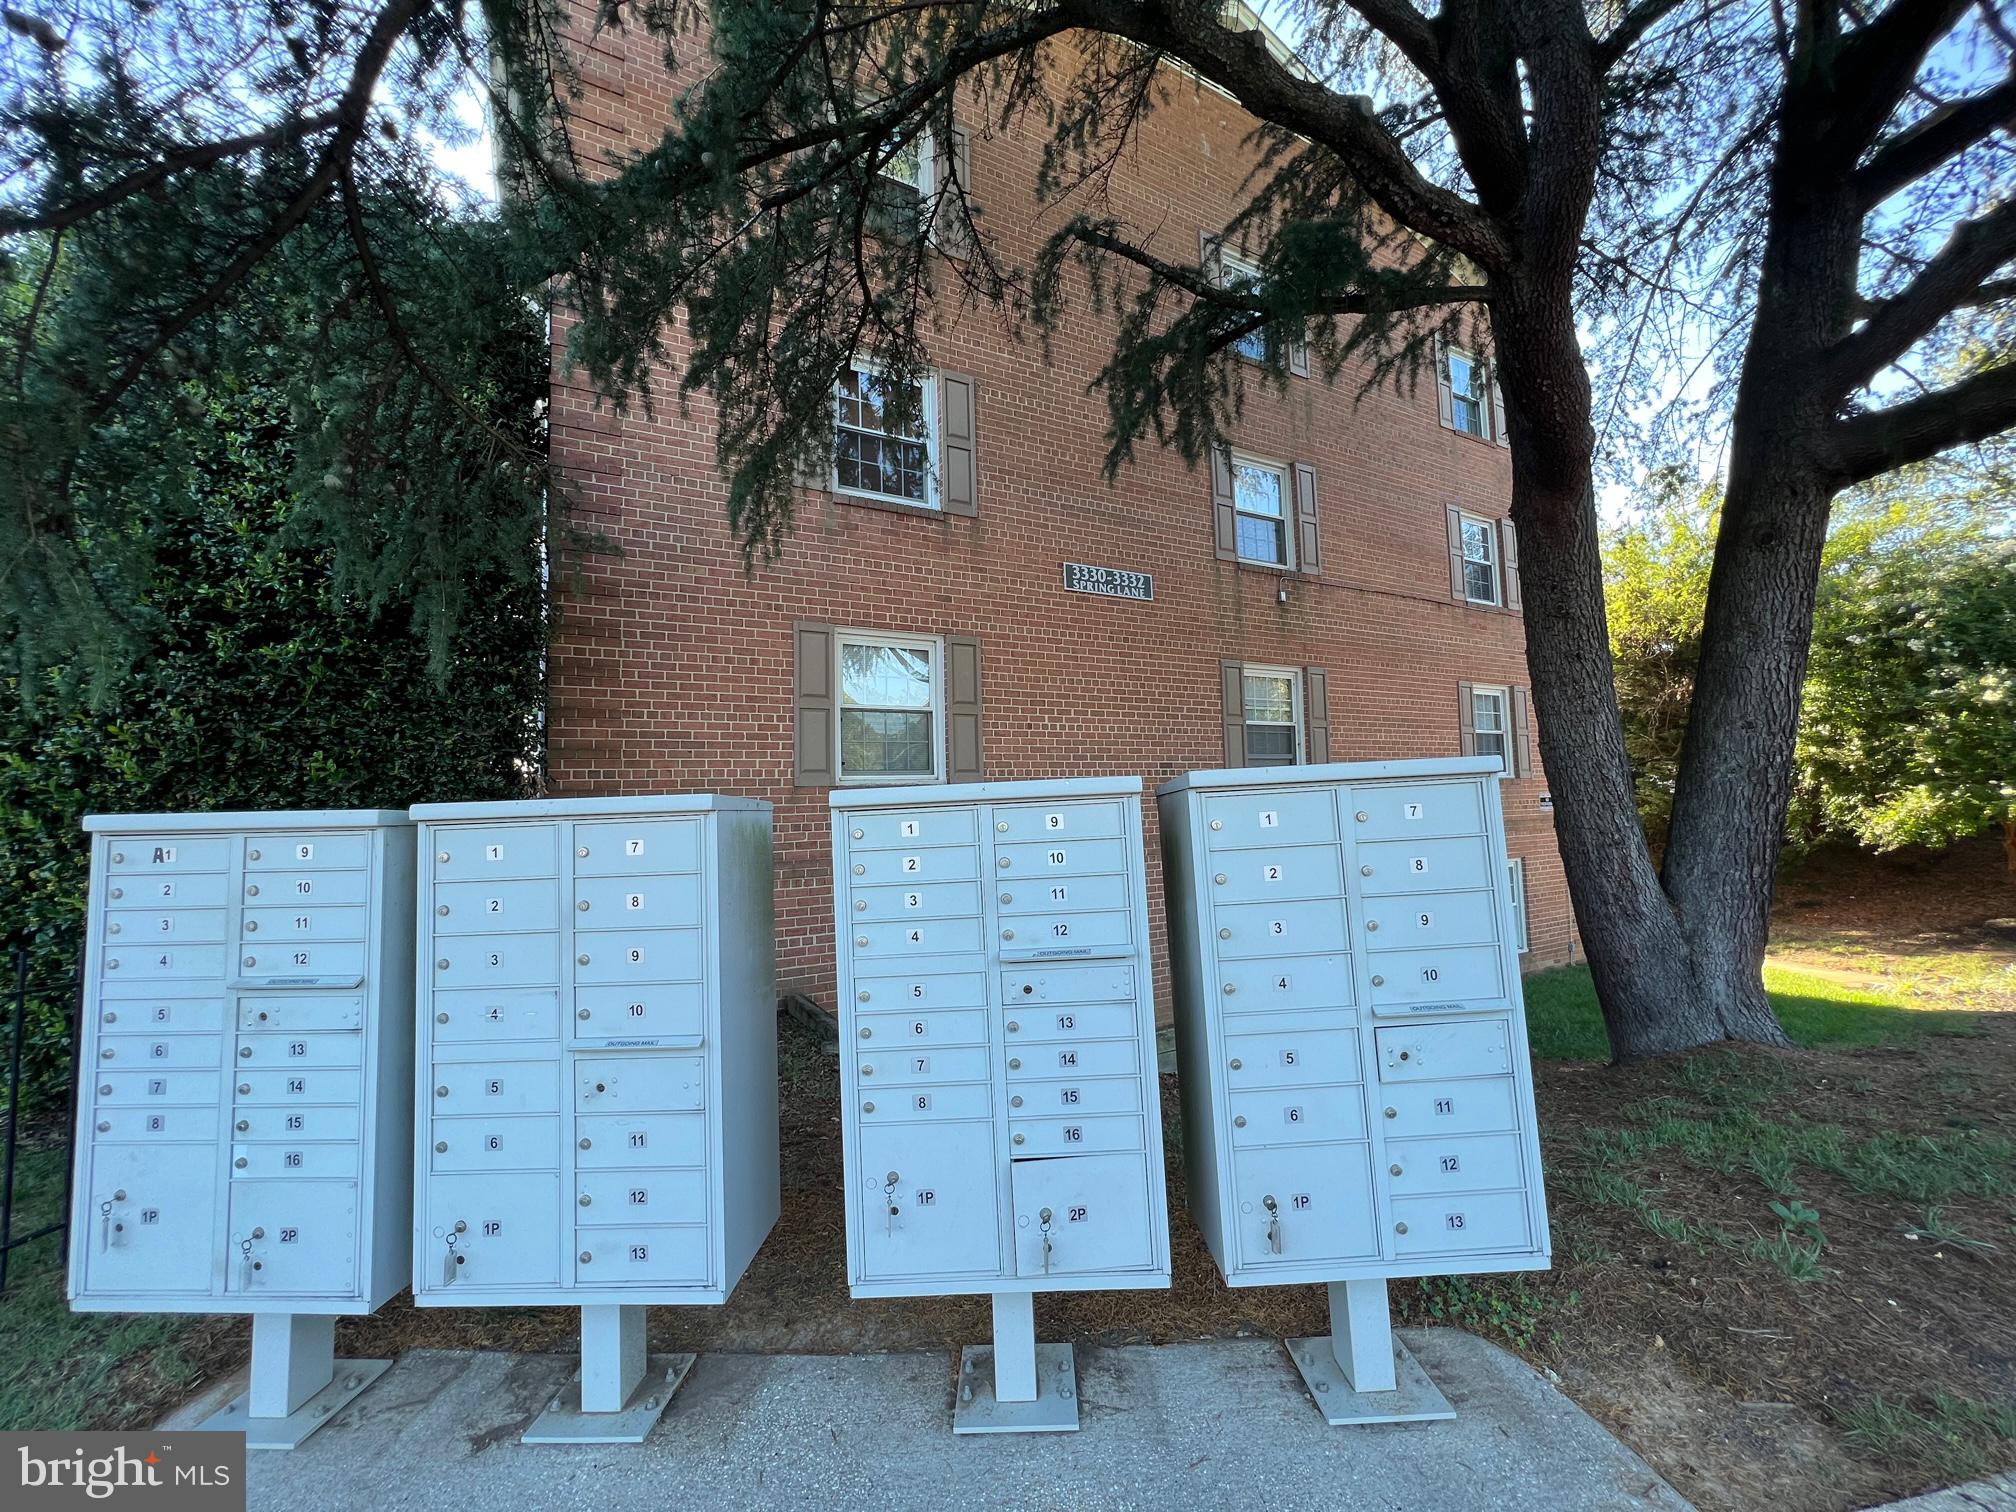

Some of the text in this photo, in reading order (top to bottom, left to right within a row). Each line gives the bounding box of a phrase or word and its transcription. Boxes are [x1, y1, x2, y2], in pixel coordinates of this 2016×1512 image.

[1072, 565, 1146, 588] 3330-3332
[1072, 579, 1147, 598] SPRING LANE
[1409, 805, 1417, 817] 7
[1050, 816, 1059, 828] 9
[1265, 813, 1272, 825] 1
[907, 823, 913, 835] 1
[301, 846, 309, 858] 9
[492, 847, 498, 859] 1
[631, 841, 639, 853] 7
[1049, 852, 1064, 864] 10
[908, 858, 916, 871] 2
[1415, 859, 1424, 871] 8
[1269, 867, 1278, 879] 2
[163, 884, 171, 896] 2
[297, 882, 311, 894] 10
[1051, 887, 1065, 900] 11
[491, 900, 499, 912] 2
[631, 896, 639, 908] 8
[909, 894, 918, 907] 3
[161, 919, 169, 931] 3
[295, 917, 308, 929] 11
[1420, 914, 1429, 926] 9
[1053, 924, 1068, 936] 12
[1274, 922, 1282, 934] 3
[911, 930, 920, 942] 4
[159, 955, 168, 967] 4
[293, 953, 307, 965] 12
[491, 954, 499, 966] 3
[631, 950, 639, 962] 9
[1423, 969, 1438, 981] 10
[1278, 977, 1287, 989] 4
[913, 985, 922, 998] 5
[158, 1008, 166, 1021] 5
[490, 1008, 499, 1020] 4
[629, 1004, 643, 1017] 10
[915, 1022, 923, 1035] 6
[1058, 1016, 1074, 1029] 13
[155, 1045, 163, 1057] 6
[290, 1043, 305, 1056] 13
[1061, 1053, 1076, 1065] 14
[1286, 1052, 1294, 1065] 5
[917, 1059, 925, 1072] 7
[153, 1081, 162, 1094] 7
[289, 1080, 303, 1092] 14
[491, 1081, 499, 1093] 5
[918, 1096, 926, 1109] 8
[1062, 1090, 1078, 1103] 15
[1436, 1100, 1451, 1113] 11
[1290, 1109, 1298, 1122] 6
[151, 1117, 160, 1130] 8
[287, 1116, 302, 1129] 15
[631, 1134, 644, 1147] 11
[1065, 1128, 1080, 1141] 16
[490, 1137, 498, 1149] 6
[286, 1153, 300, 1166] 16
[1441, 1158, 1458, 1171] 12
[630, 1191, 645, 1203] 12
[918, 1191, 934, 1204] 1P
[1293, 1195, 1309, 1209] 1P
[142, 1210, 158, 1223] 1P
[1070, 1208, 1086, 1222] 2P
[1448, 1215, 1464, 1228] 13
[484, 1222, 500, 1235] 1P
[281, 1229, 297, 1242] 2P
[631, 1247, 646, 1260] 13
